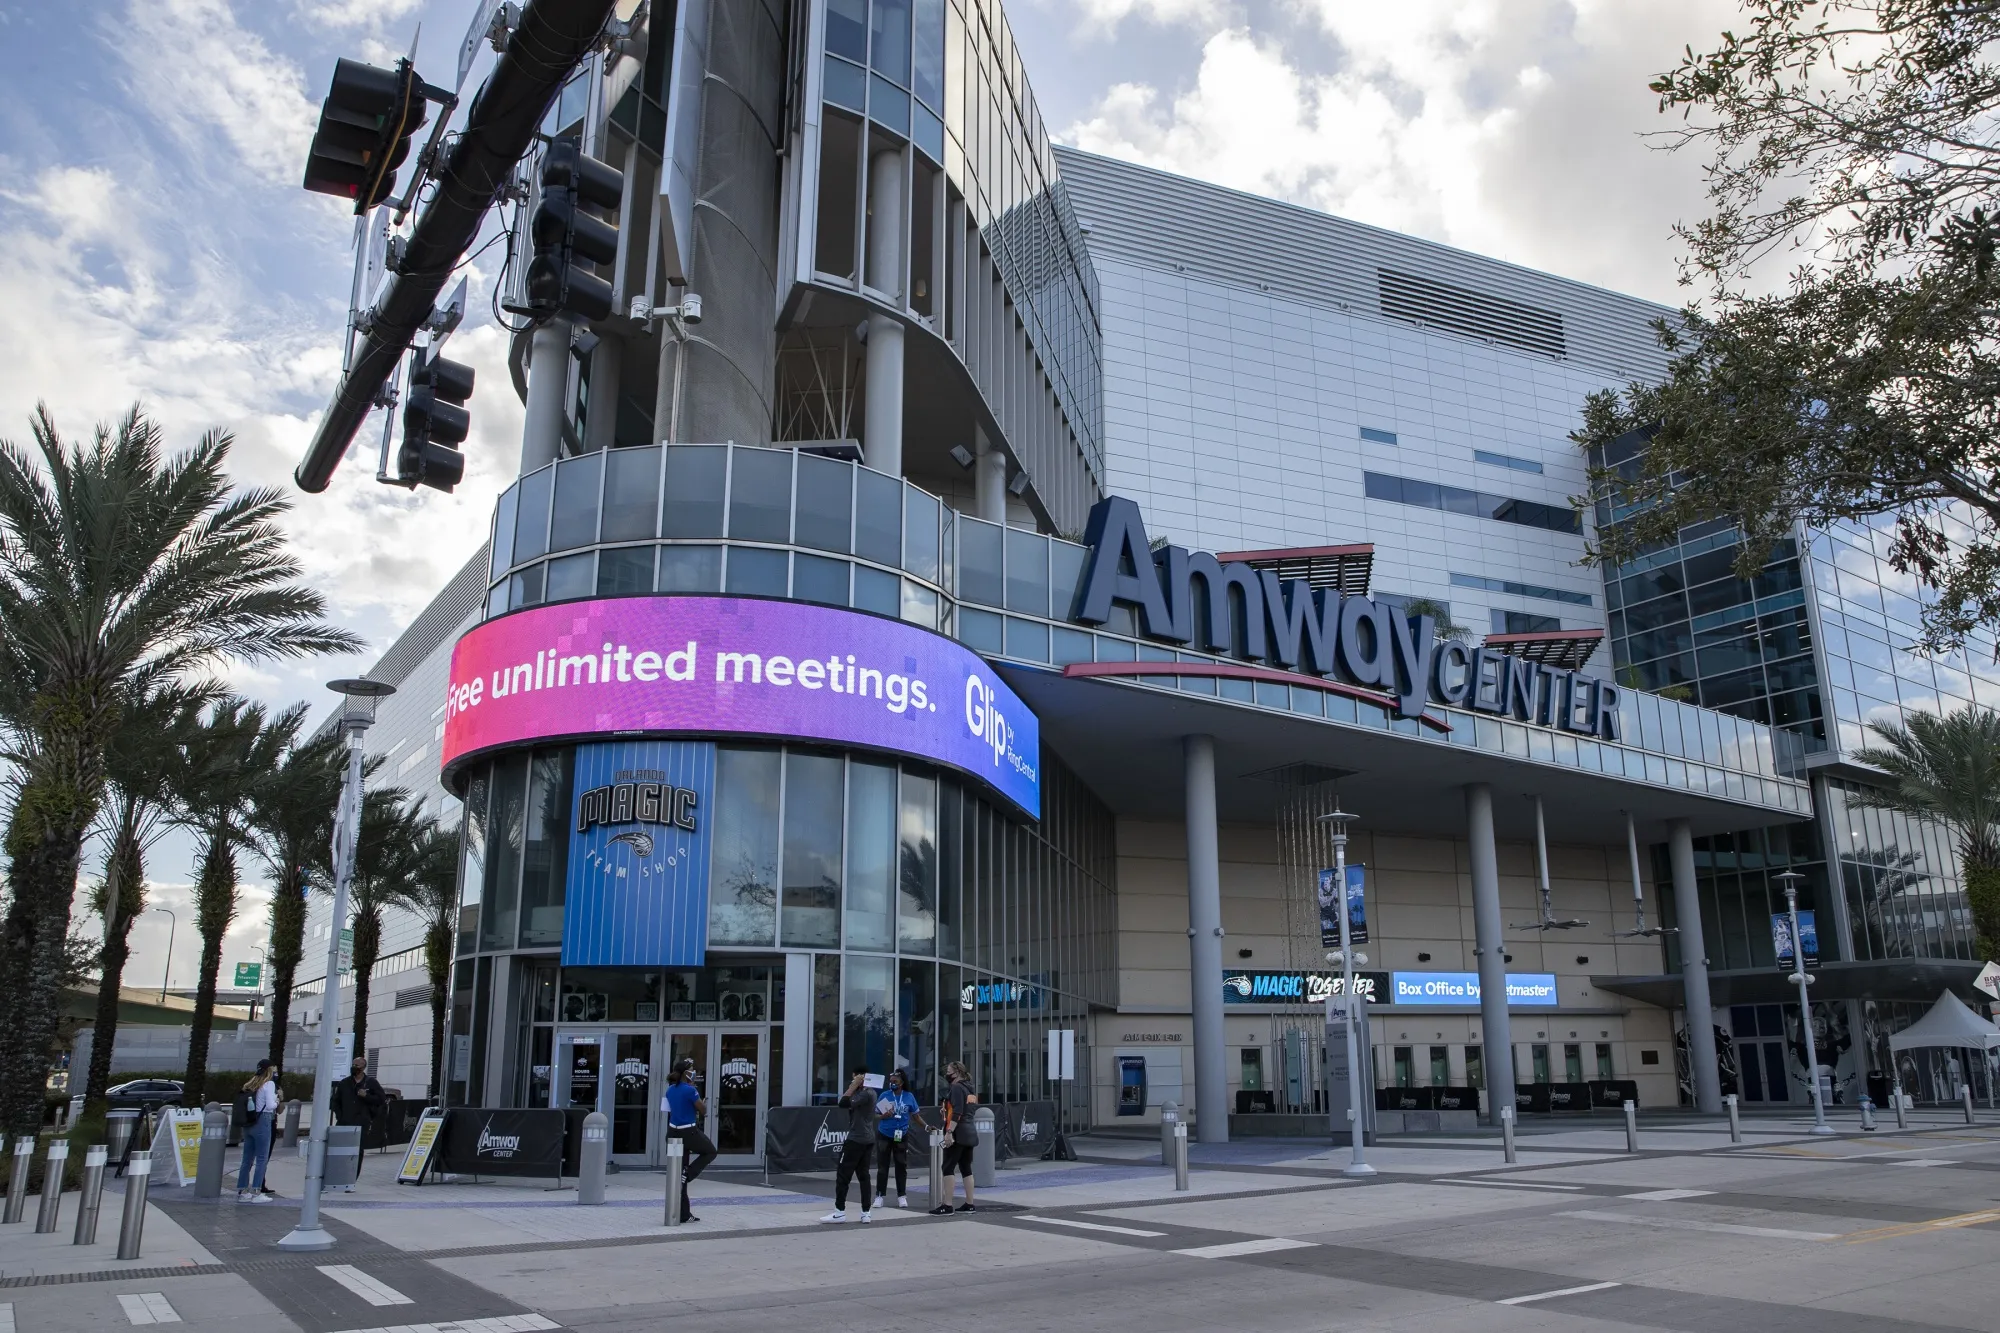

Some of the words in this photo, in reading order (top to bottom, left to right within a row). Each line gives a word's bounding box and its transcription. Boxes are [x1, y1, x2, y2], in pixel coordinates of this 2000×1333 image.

[1075, 494, 1435, 719] Amway
[1428, 639, 1621, 740] CENTER
[446, 675, 484, 724] Free
[491, 641, 697, 699] unlimited
[715, 652, 937, 714] meetings.
[965, 674, 1007, 768] Glip
[1007, 722, 1015, 745] by
[1007, 745, 1036, 783] RingCentral
[615, 769, 665, 781] ORLANDO
[577, 782, 698, 833] MAGIC
[586, 849, 627, 878] TEAM
[642, 847, 687, 878] SHOP
[1252, 975, 1304, 996] MAGIC
[1398, 981, 1422, 996] Box
[1425, 981, 1464, 996] Office
[1466, 981, 1480, 999] by
[615, 1062, 649, 1076] MAGIC
[721, 1062, 757, 1077] MAGIC
[481, 1131, 520, 1150] Amway
[819, 1128, 849, 1143] Amw
[493, 1150, 514, 1158] CENTER
